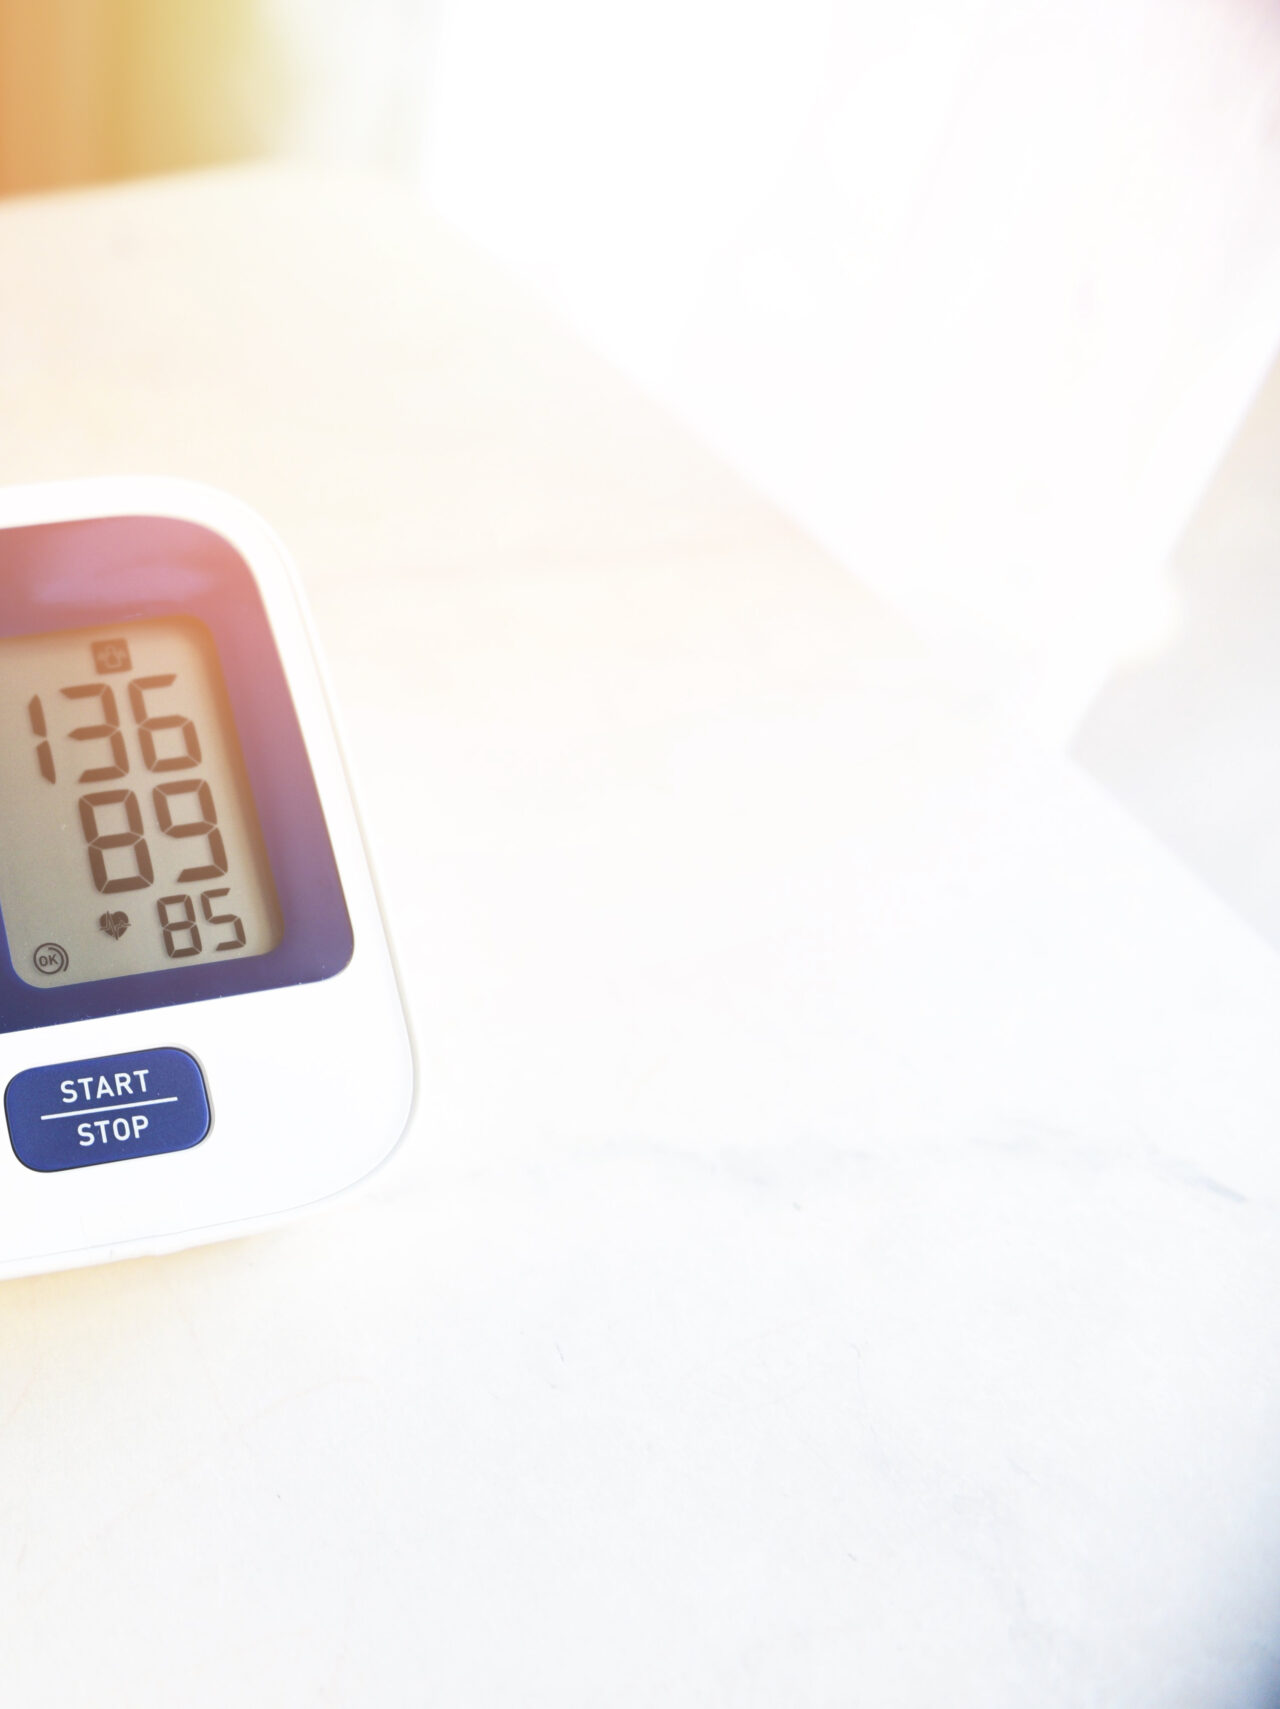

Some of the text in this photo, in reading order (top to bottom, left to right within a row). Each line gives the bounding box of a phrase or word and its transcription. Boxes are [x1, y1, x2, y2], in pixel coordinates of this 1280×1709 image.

[27, 673, 202, 785] 136
[78, 778, 229, 894] 89
[157, 887, 247, 958] 85
[38, 954, 58, 967] OK
[60, 1069, 149, 1103] START
[77, 1115, 149, 1147] STOP
